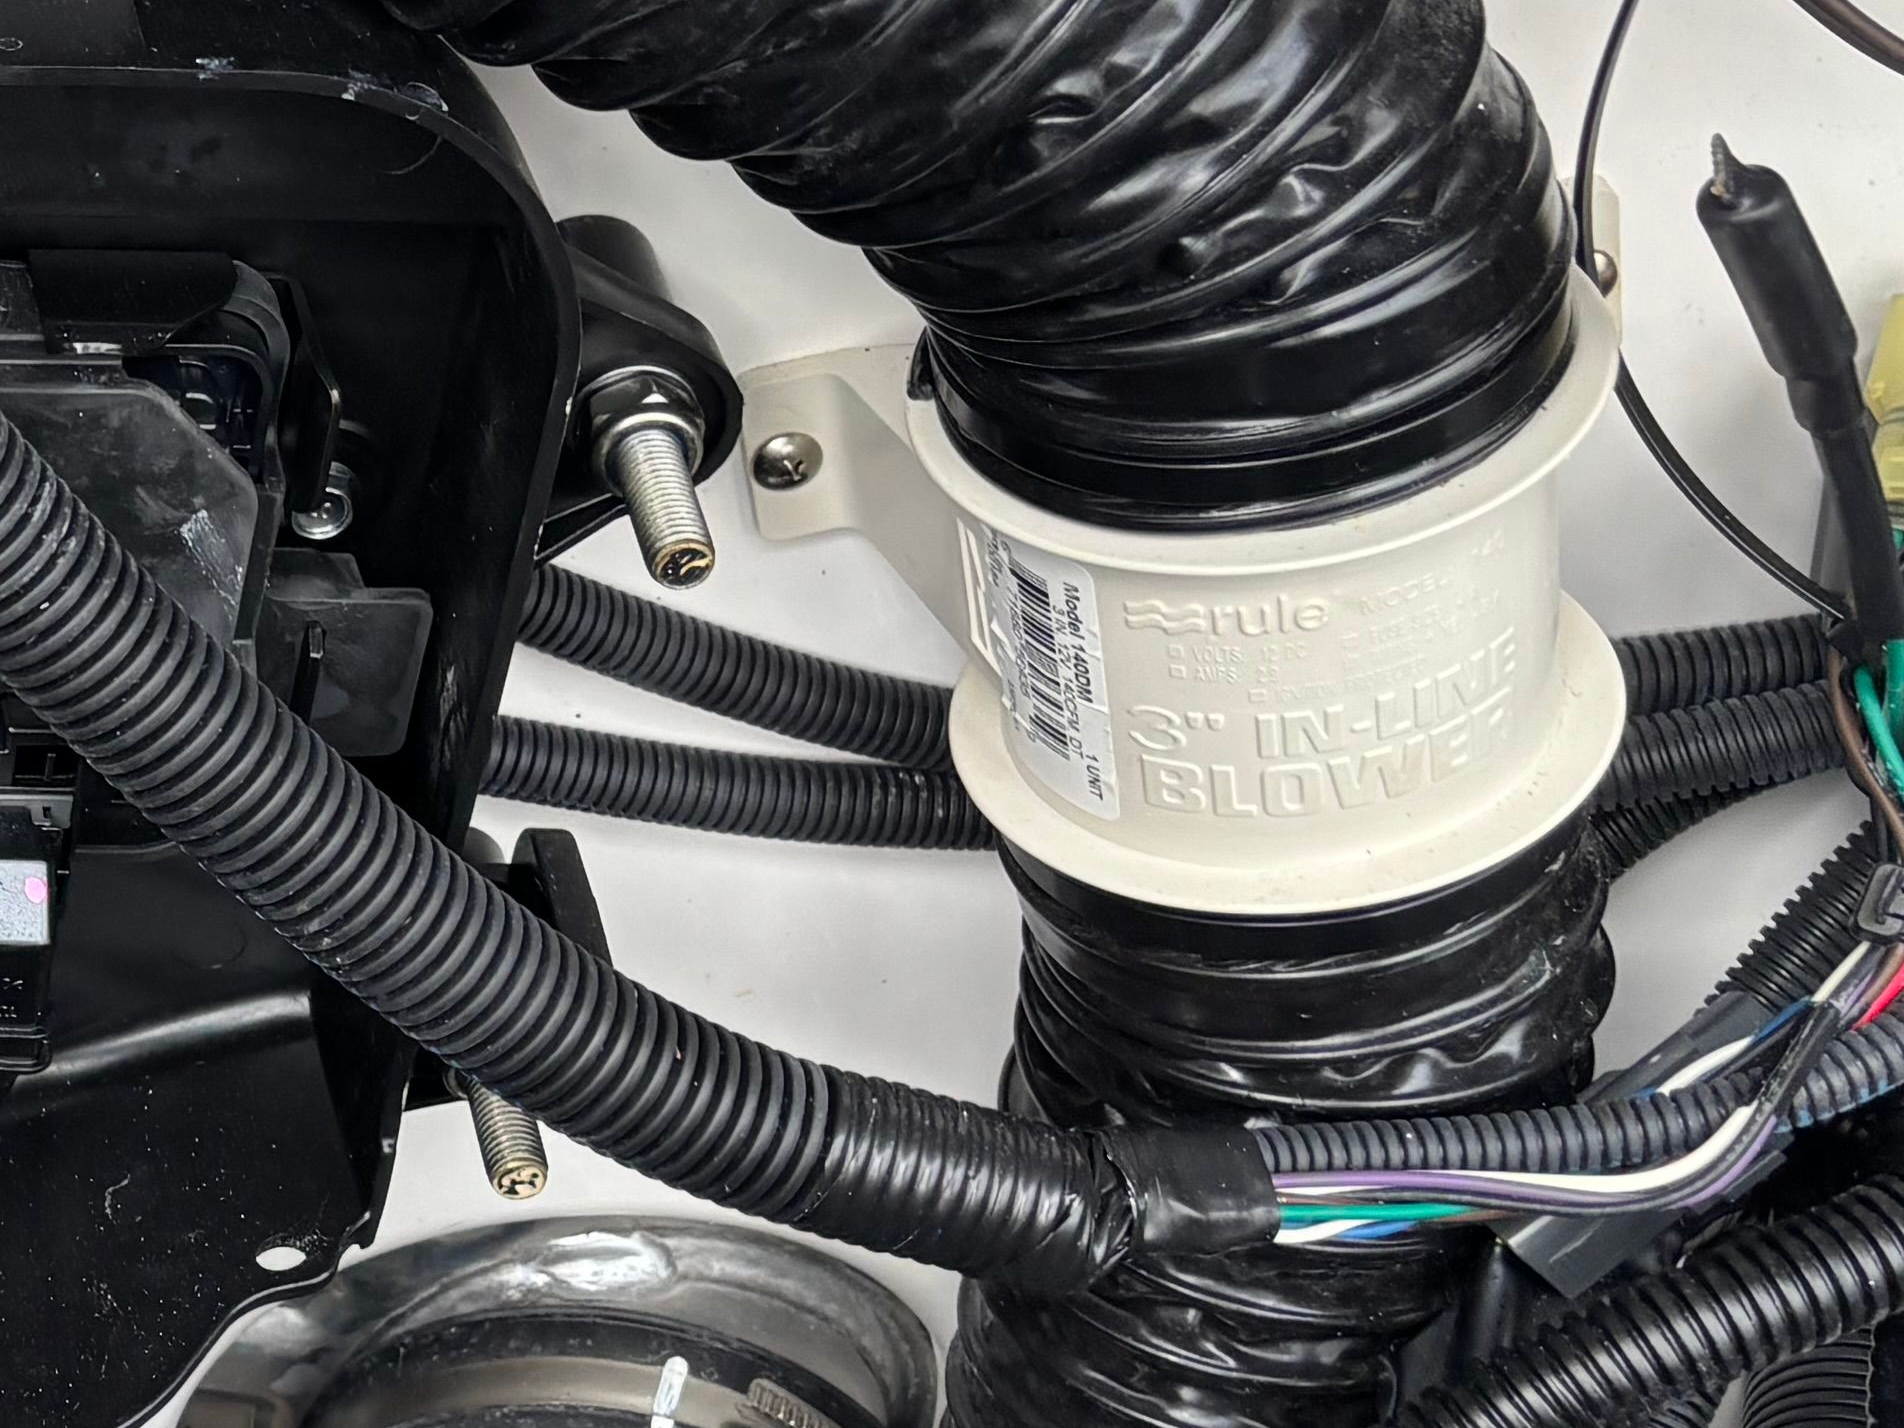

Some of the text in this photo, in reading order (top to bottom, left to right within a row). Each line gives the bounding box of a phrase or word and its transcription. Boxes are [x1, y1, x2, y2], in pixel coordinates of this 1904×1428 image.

[1063, 581, 1094, 704] Model 140DM
[1211, 593, 1329, 636] rule
[1138, 685, 1515, 819] BLOWER
[1254, 625, 1517, 760] IN-LINE
[1087, 763, 1103, 801] UNIT
